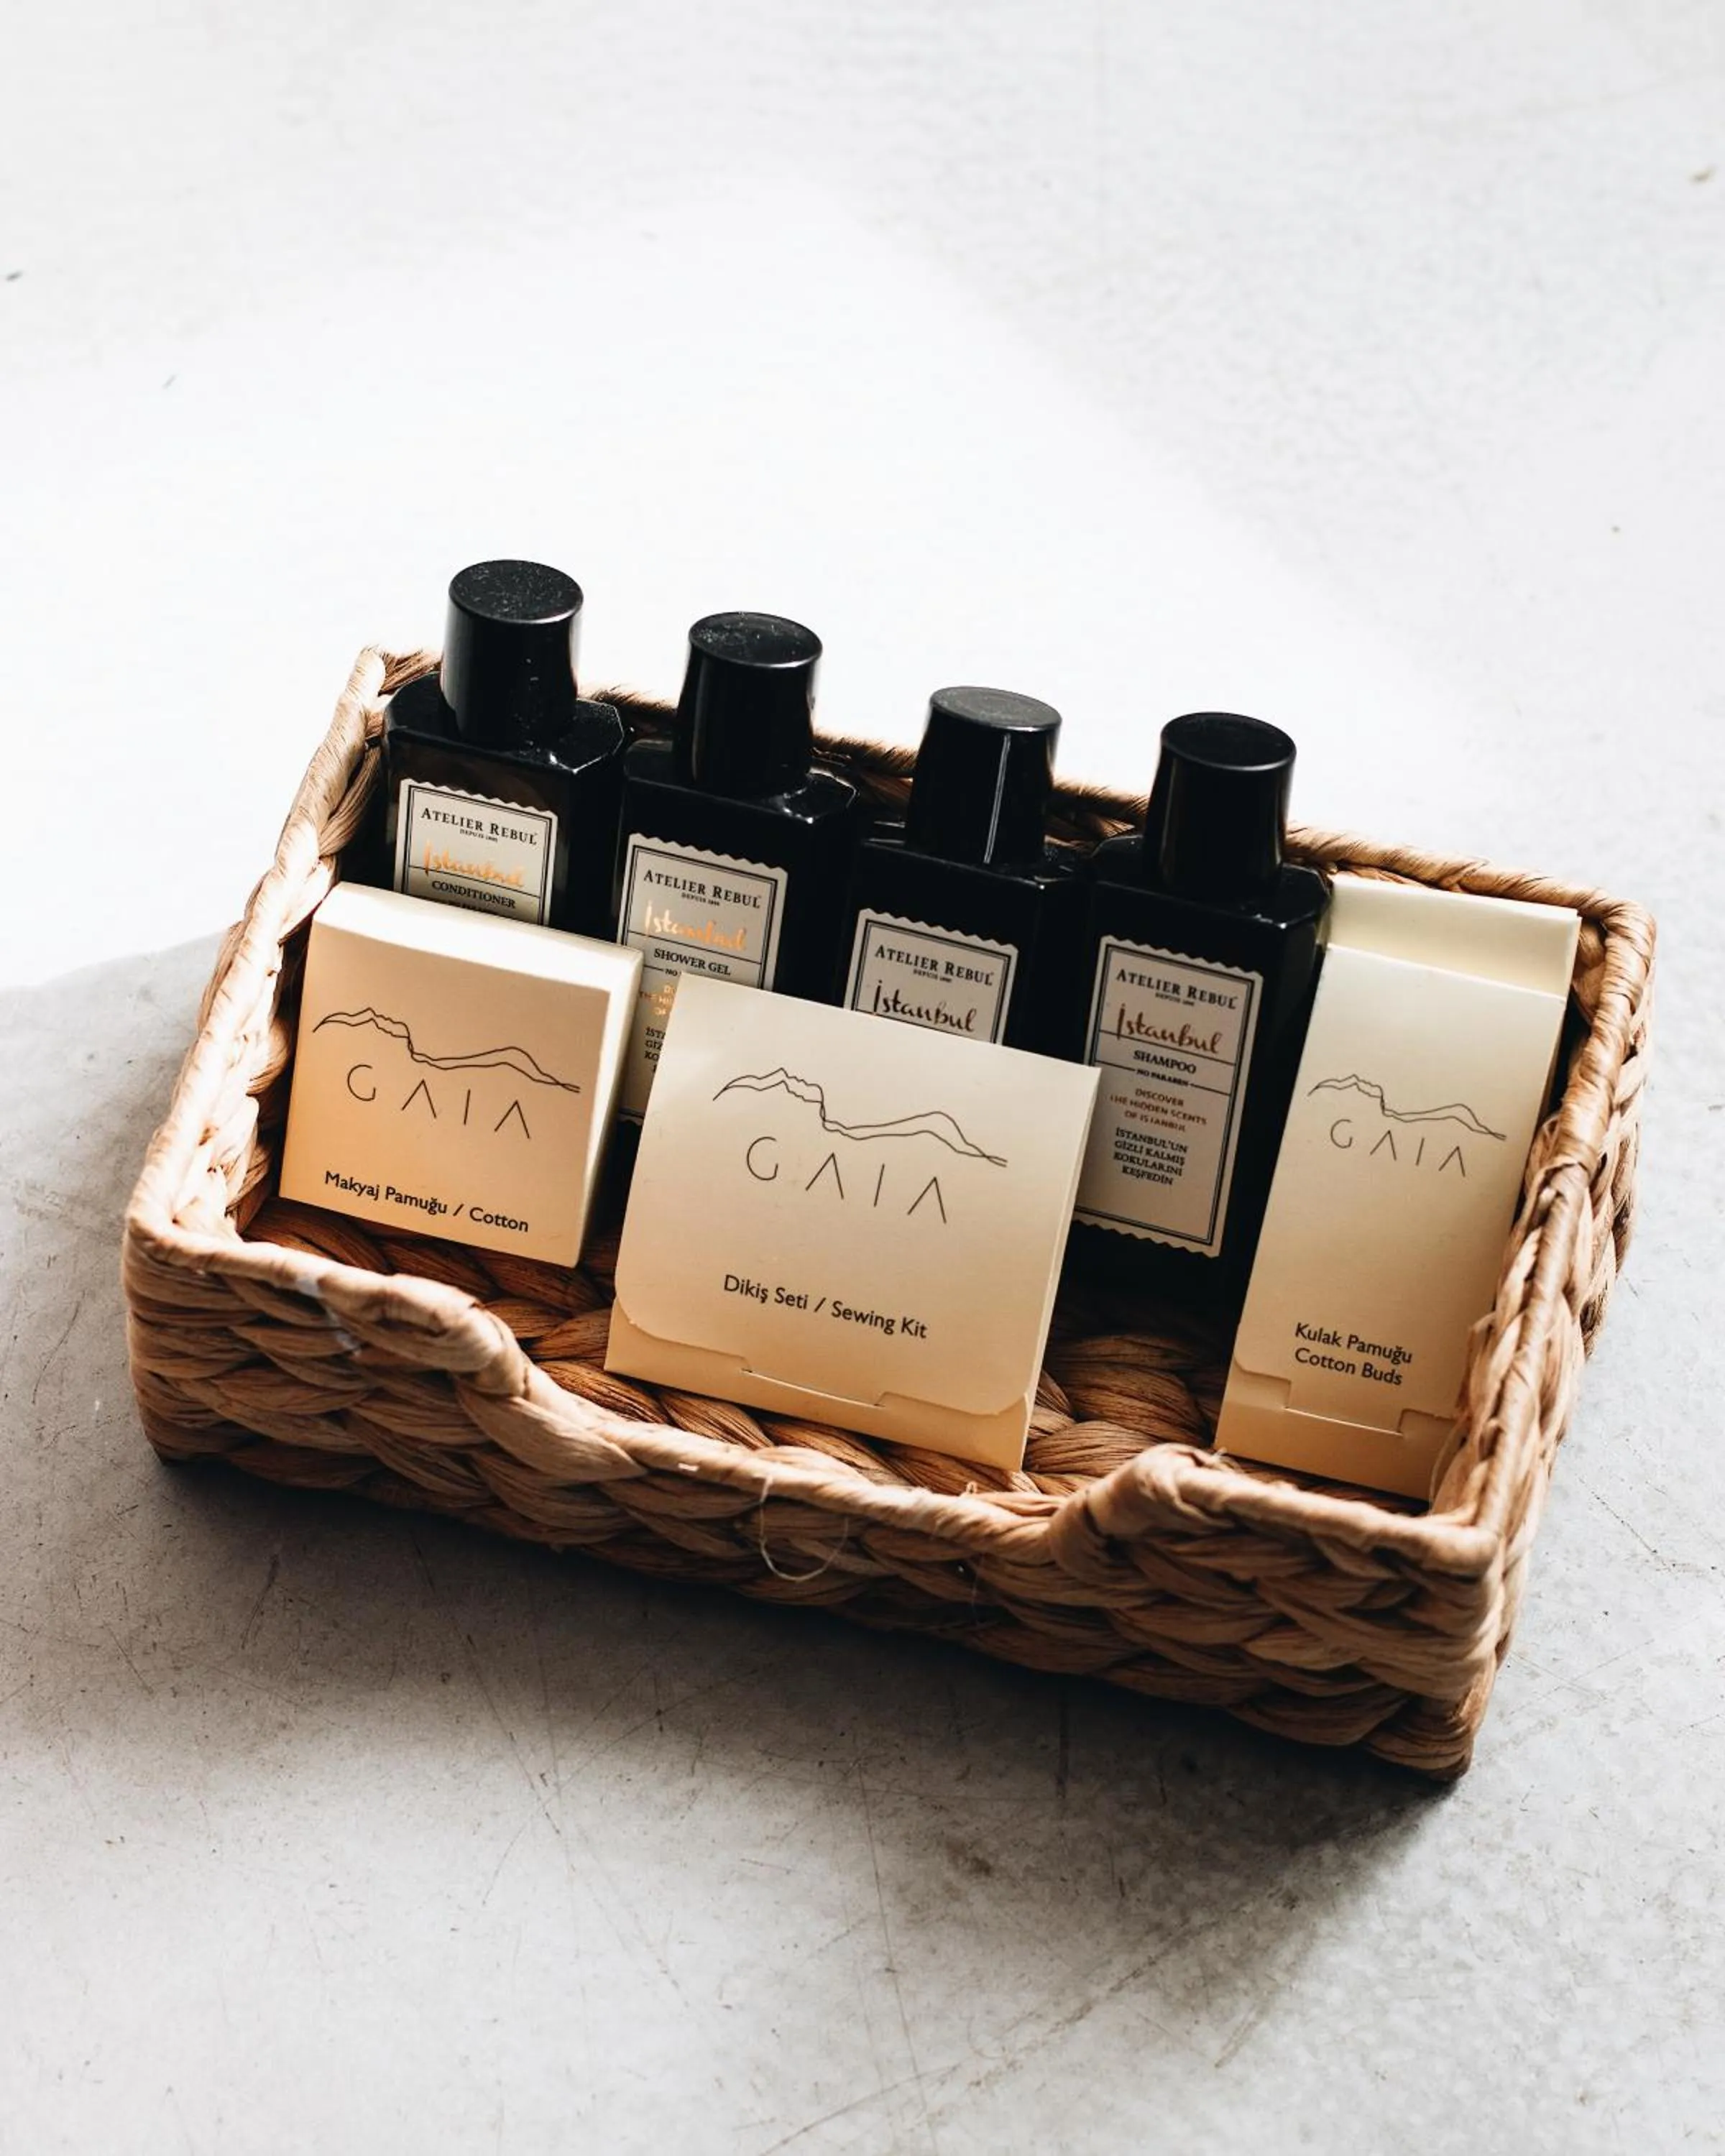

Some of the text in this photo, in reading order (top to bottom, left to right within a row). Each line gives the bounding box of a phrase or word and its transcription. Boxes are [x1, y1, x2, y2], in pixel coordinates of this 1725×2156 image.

[420, 808, 538, 845] ATELIER REBUL
[432, 880, 515, 908] CONDITIONER
[644, 870, 760, 908] ATELIER REBUL
[654, 949, 731, 975] SHOWER GEL
[875, 945, 993, 986] ATELIER REBUL
[1116, 969, 1238, 1010] ATELIER REBUL
[1133, 1049, 1197, 1074] SHAMPOO
[347, 1064, 530, 1139] GAIA
[1110, 1094, 1208, 1125] THE HIDDEN SCENTS
[1124, 1110, 1137, 1119] OF
[1135, 1088, 1184, 1107] DISCOVER
[1330, 1118, 1466, 1177] GAIA
[747, 1136, 947, 1224] GAIA
[324, 1170, 530, 1233] Makyaj Pamuğu / Cotton
[723, 1273, 929, 1340] Dikiş Seti / Sewing Kit
[1294, 1322, 1413, 1364] Kulak Pamuğu
[1294, 1347, 1403, 1386] Cotton Buds
